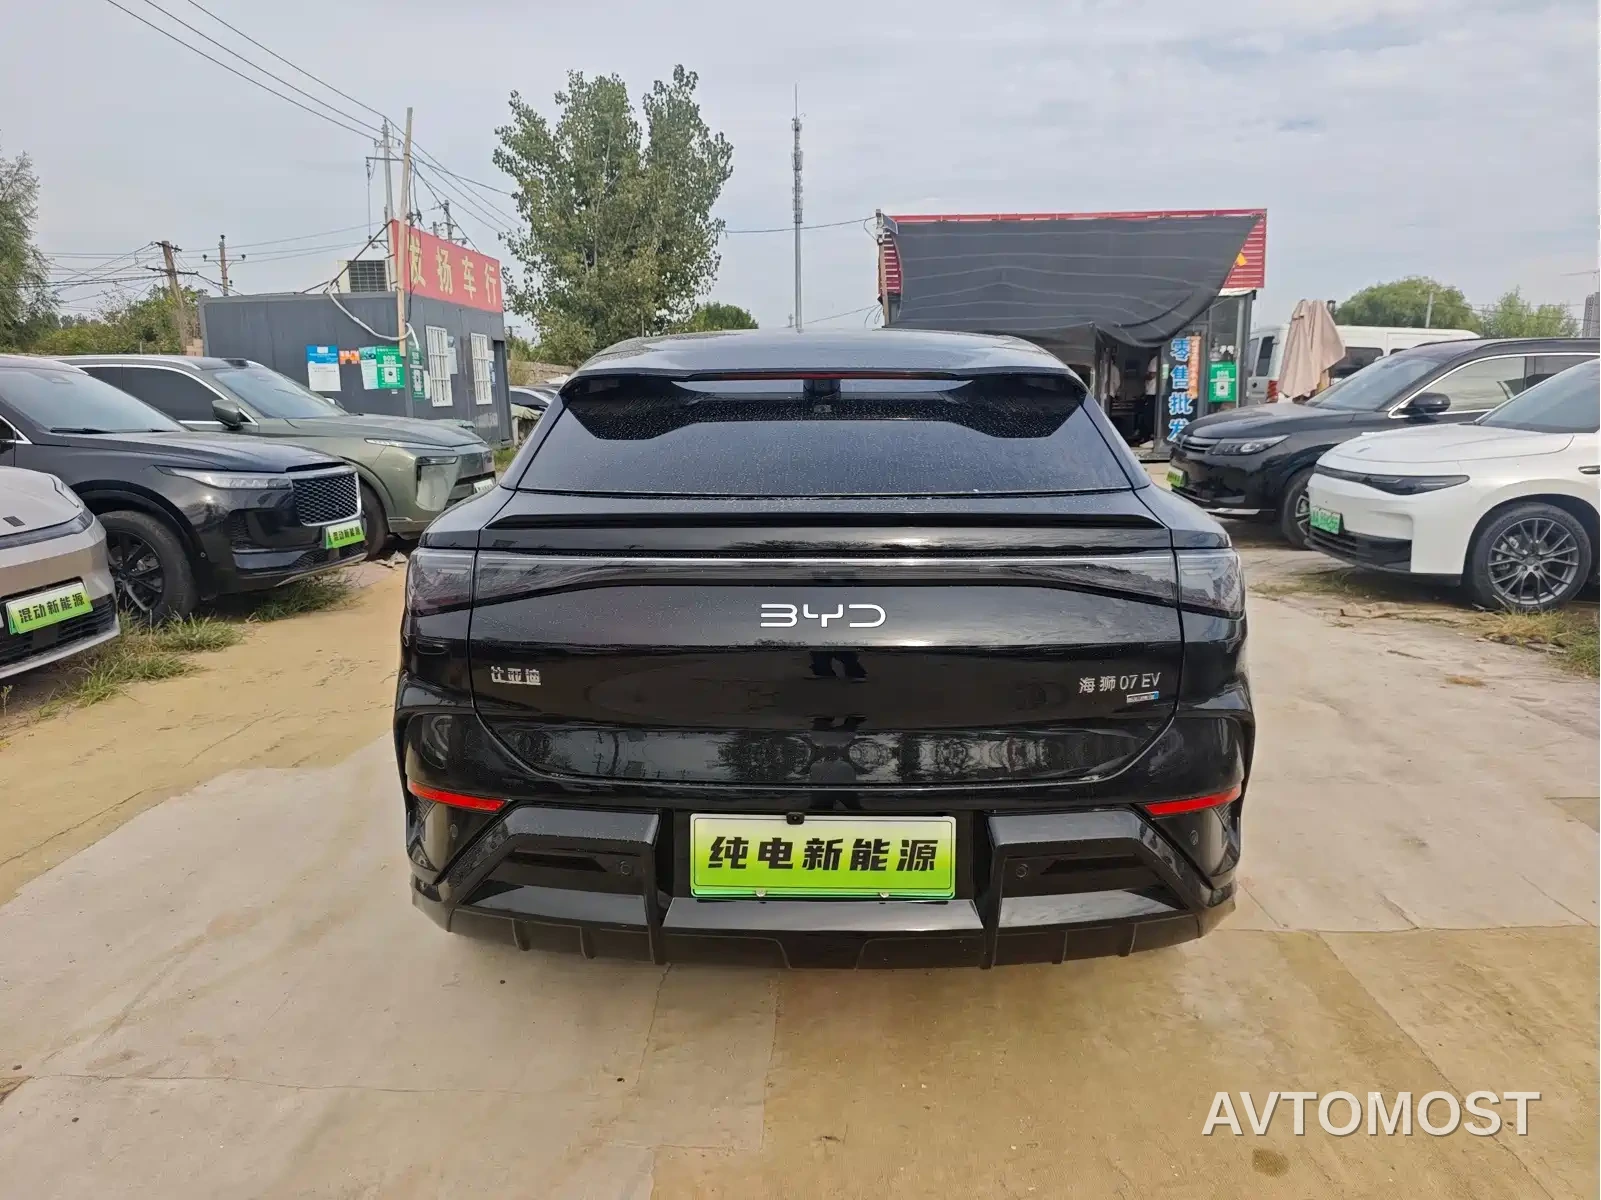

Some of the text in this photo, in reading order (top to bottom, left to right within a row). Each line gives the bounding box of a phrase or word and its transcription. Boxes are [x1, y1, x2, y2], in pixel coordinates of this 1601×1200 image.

[407, 232, 497, 306] 发扬车行
[18, 592, 86, 624] 混动新能源
[760, 603, 887, 628] BYD
[490, 665, 541, 686] 比亚迪
[1119, 674, 1138, 690] 07
[1141, 672, 1161, 688] EV
[708, 836, 939, 872] 纯电新能源
